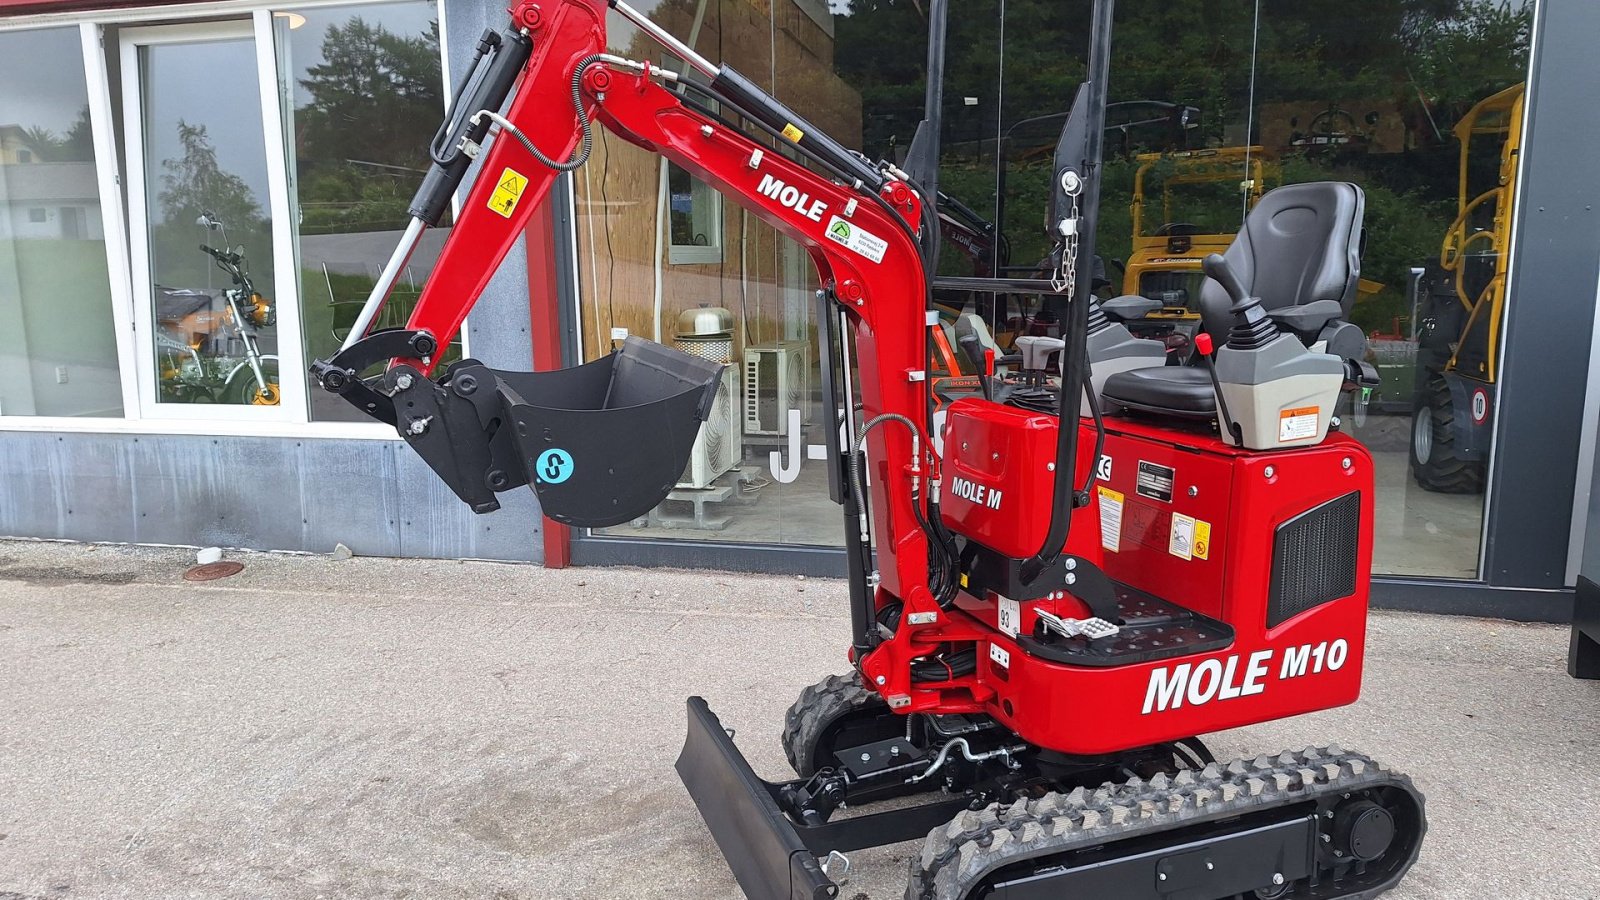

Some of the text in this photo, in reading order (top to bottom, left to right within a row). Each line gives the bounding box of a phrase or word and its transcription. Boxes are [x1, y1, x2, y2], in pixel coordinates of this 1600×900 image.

[757, 173, 828, 222] MOLE
[1475, 397, 1483, 415] 10
[951, 476, 985, 503] MOLE
[1000, 609, 1010, 629] 93
[1141, 638, 1348, 715] MOLE M10
